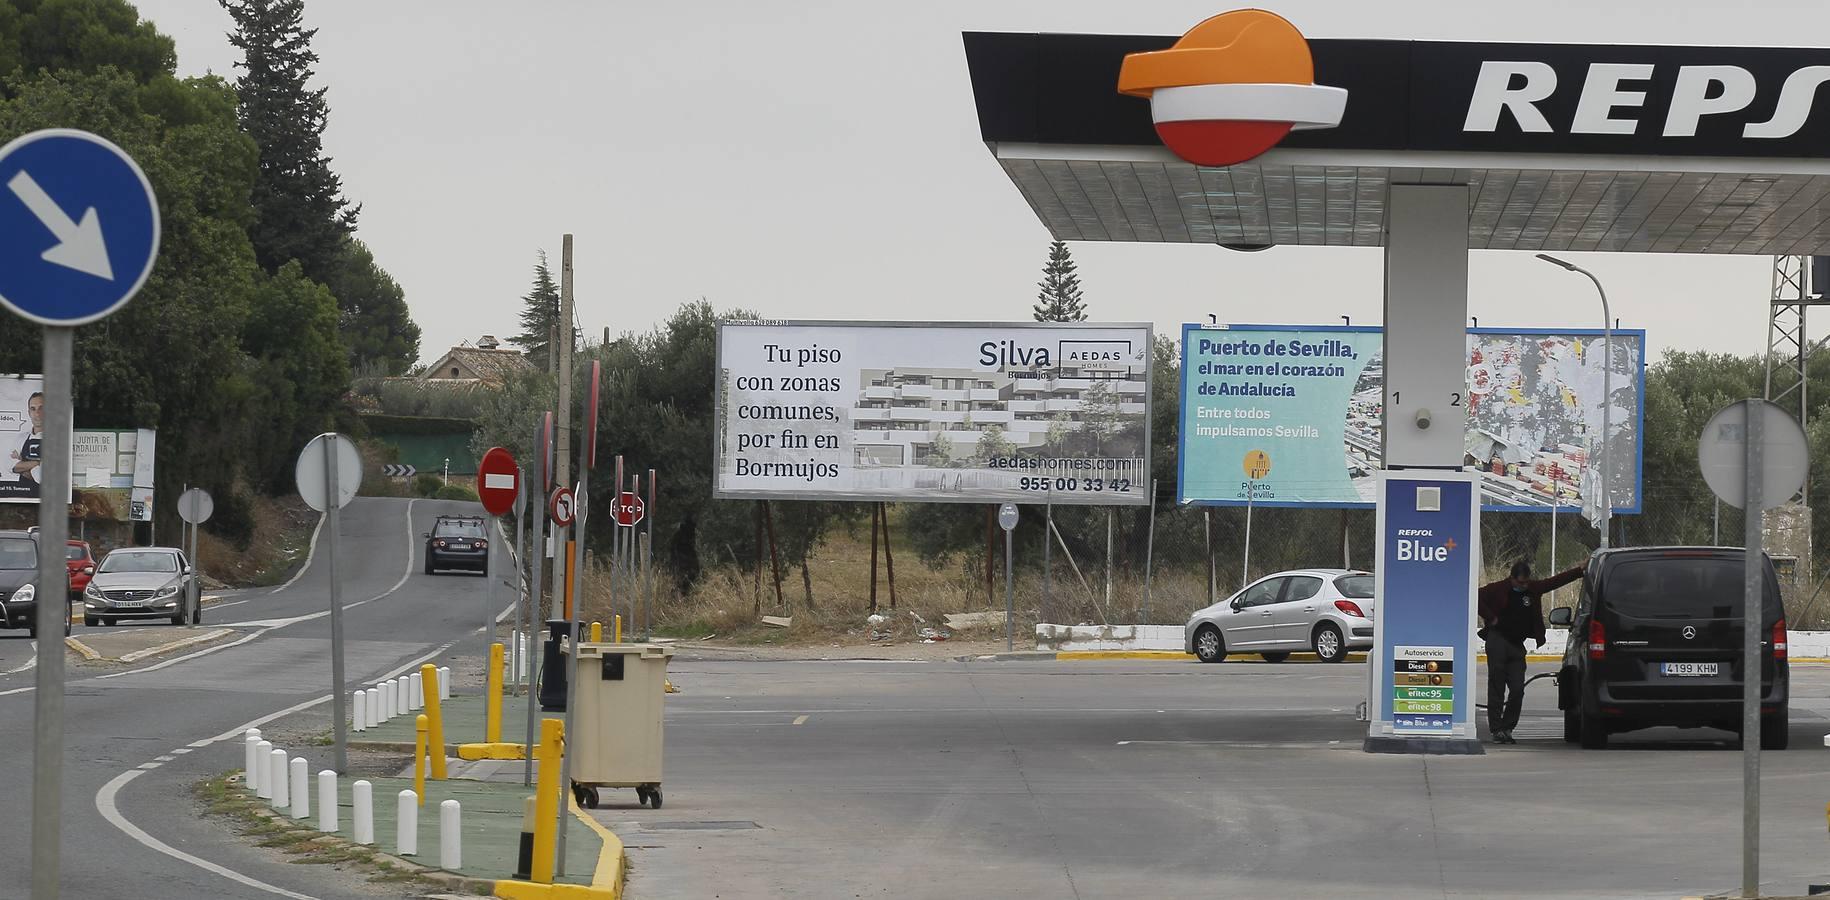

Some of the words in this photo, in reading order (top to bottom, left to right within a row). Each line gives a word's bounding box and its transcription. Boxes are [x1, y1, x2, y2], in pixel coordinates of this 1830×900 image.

[764, 345, 792, 363] Tu
[798, 344, 841, 367] piso
[979, 340, 1051, 367] Silva
[1069, 351, 1121, 361] AEDAS
[1199, 339, 1261, 356] Puerto
[1264, 340, 1286, 356] de
[1289, 340, 1358, 360] Sevilla,
[1198, 361, 1212, 375] el
[1213, 365, 1243, 376] mar
[1245, 365, 1264, 376] en
[1266, 362, 1280, 376] el
[1281, 363, 1345, 377] corazón
[736, 376, 774, 391] con
[780, 376, 840, 392] zonas
[1198, 382, 1217, 396] de
[1218, 382, 1296, 397] Andalucía
[1392, 391, 1400, 405] 1
[1450, 392, 1460, 406] 2
[737, 404, 840, 423] comunes,
[1197, 406, 1231, 419] Entre
[1234, 406, 1271, 419] todos
[1196, 423, 1273, 439] impulsamos
[1275, 425, 1319, 438] Sevilla
[77, 436, 99, 444] JUNTA
[102, 436, 110, 444] DE
[737, 433, 775, 452] por
[780, 429, 808, 448] fin
[814, 433, 839, 448] en
[735, 458, 839, 482] Bormujos
[988, 455, 1131, 470] aedashomes.com
[1020, 477, 1050, 491] 955
[1055, 478, 1078, 491] 00
[1083, 478, 1103, 492] 33
[1108, 479, 1130, 492] 42
[1398, 529, 1433, 537] REPSOL
[1404, 649, 1444, 657] Autoservicio
[1667, 663, 1693, 673] 4199
[1697, 664, 1717, 673] KHM
